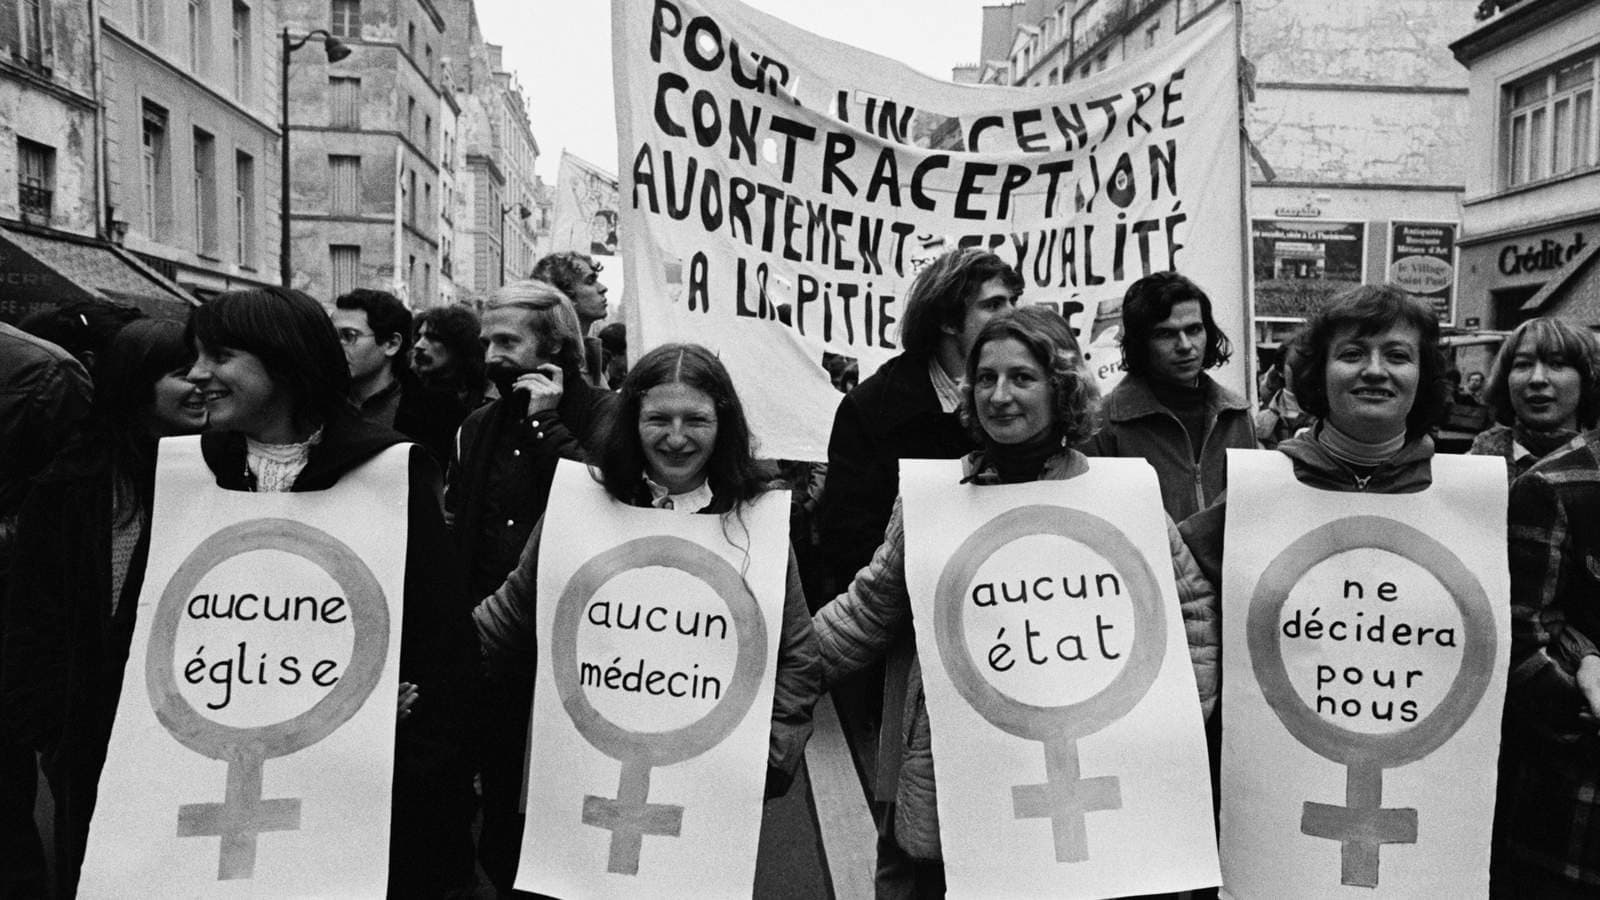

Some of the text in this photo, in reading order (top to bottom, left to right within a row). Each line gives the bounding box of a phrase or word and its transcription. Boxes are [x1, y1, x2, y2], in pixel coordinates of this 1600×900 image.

[649, 0, 801, 106] POUR
[968, 68, 1186, 153] CENTRE
[1498, 239, 1564, 276] Crédit
[688, 251, 710, 314] A
[736, 257, 777, 321] LA
[187, 593, 347, 624] aucune
[972, 573, 1121, 607] aucun
[1343, 579, 1399, 602] ne
[588, 601, 727, 640] aucun
[1282, 607, 1457, 648] décidera
[988, 614, 1121, 672] état
[184, 641, 339, 710] église
[580, 657, 721, 700] médecin
[1317, 665, 1424, 691] pour
[1316, 695, 1419, 723] nous
